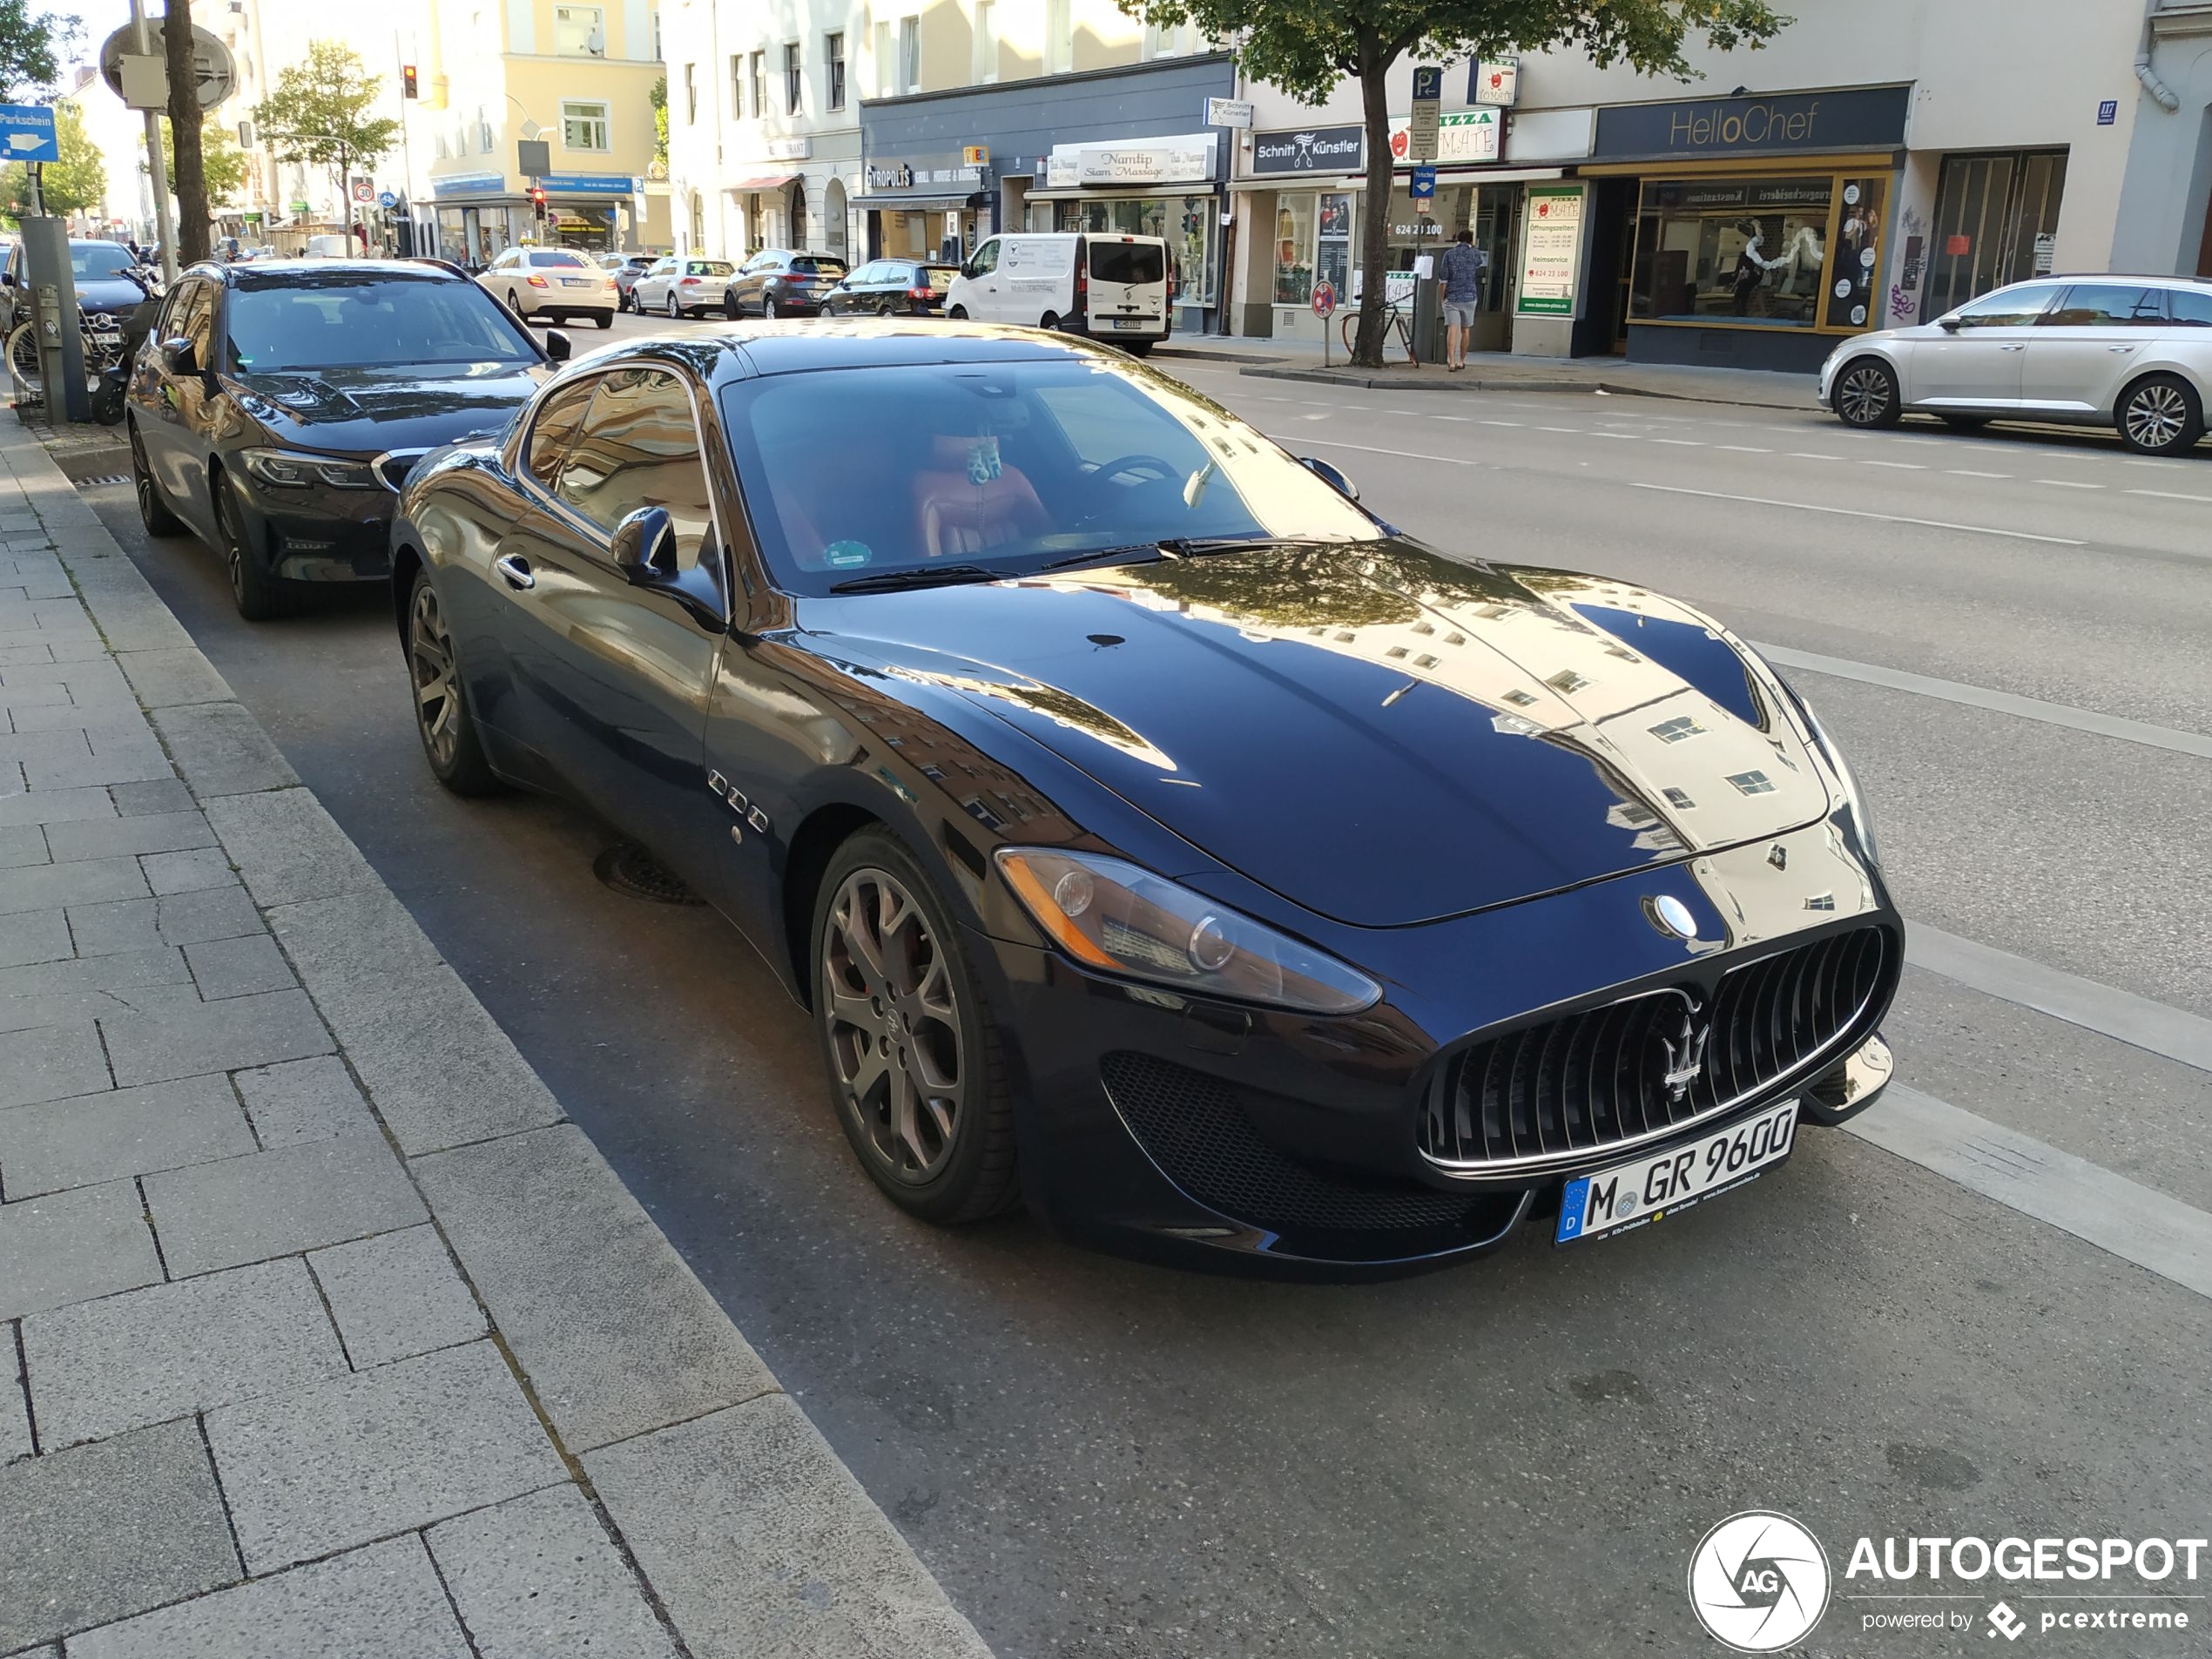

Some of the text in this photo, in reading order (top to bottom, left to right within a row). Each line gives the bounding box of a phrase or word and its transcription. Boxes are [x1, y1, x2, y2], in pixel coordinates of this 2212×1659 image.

[1417, 71, 1433, 96] P
[1478, 89, 1513, 102] TOMATE
[1223, 109, 1251, 118] Künstler
[2101, 103, 2115, 115] 117
[0, 113, 51, 126] Parkschein
[1440, 112, 1493, 127] IZZA
[1670, 102, 1819, 145] HelloChef
[1440, 125, 1494, 155] MATE
[1258, 139, 1359, 158] Schnitt Künstler
[1101, 152, 1153, 169] Namtip
[1084, 167, 1112, 177] Siam
[1116, 167, 1164, 179] Massage
[359, 188, 370, 198] 30
[1395, 225, 1411, 234] 624
[1426, 225, 1442, 235] 100
[1530, 224, 1577, 233] Öffnungszeiten:
[1586, 1108, 1793, 1226] M GR 9600
[1565, 1217, 1575, 1231] D
